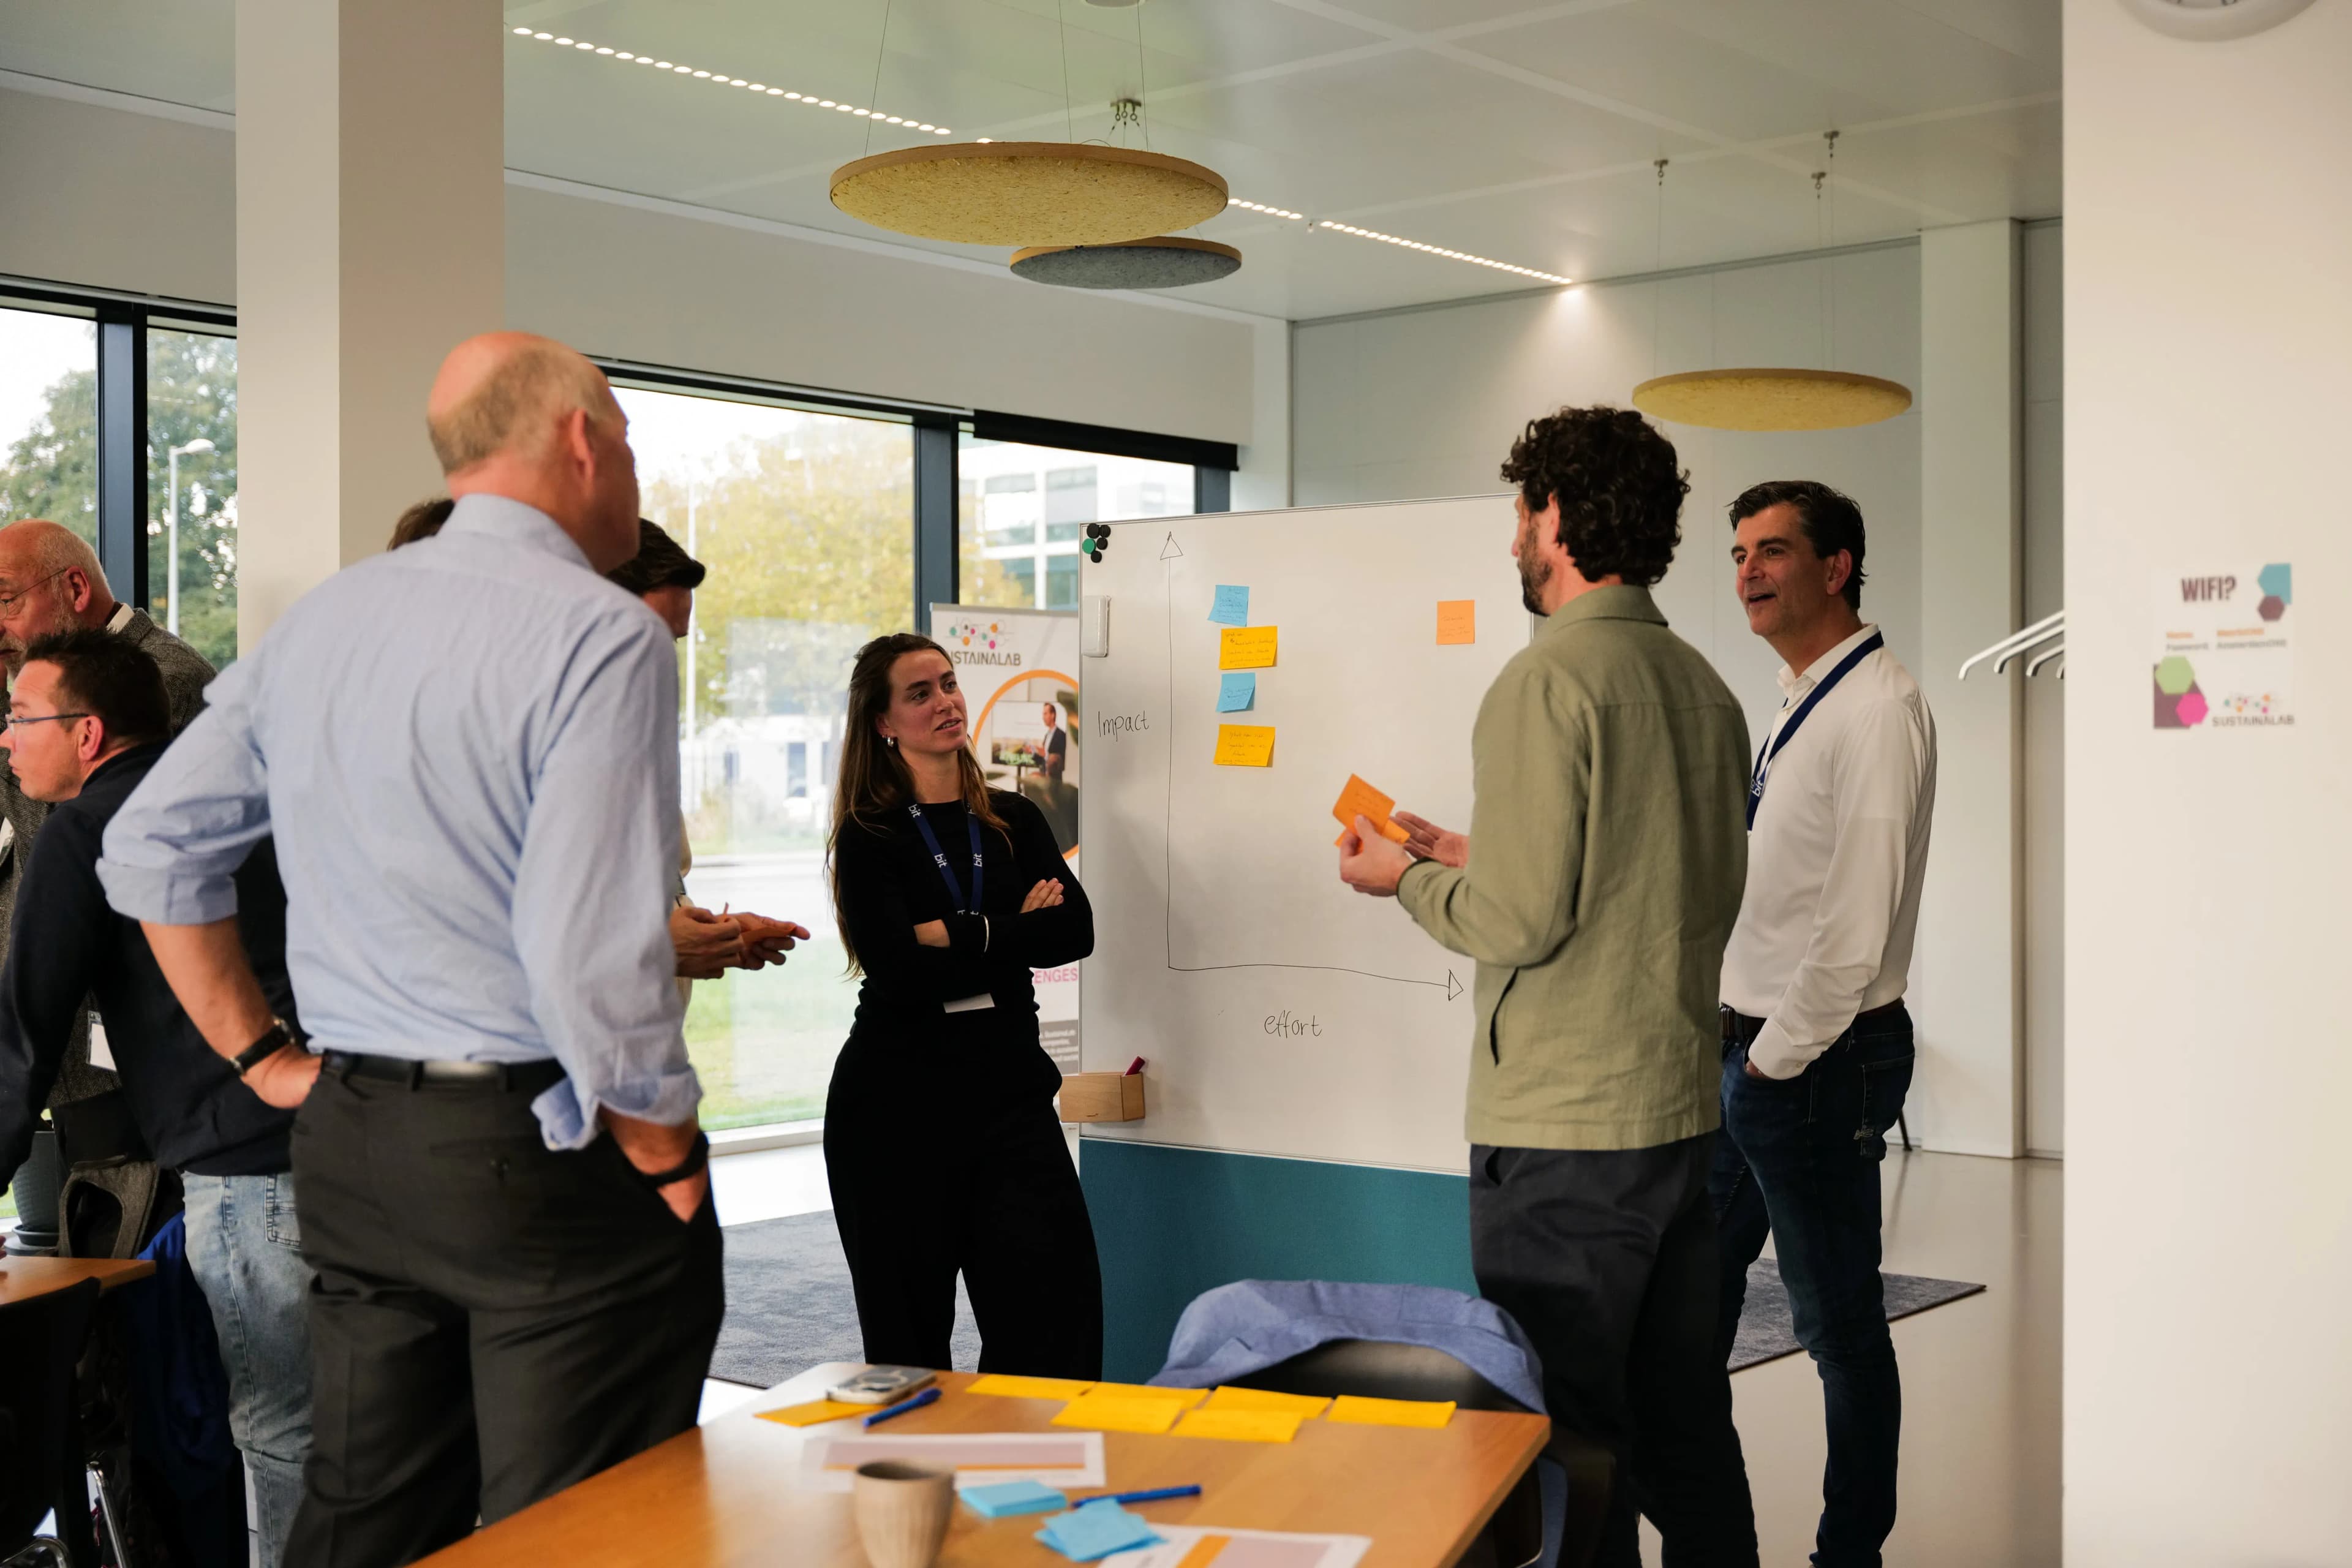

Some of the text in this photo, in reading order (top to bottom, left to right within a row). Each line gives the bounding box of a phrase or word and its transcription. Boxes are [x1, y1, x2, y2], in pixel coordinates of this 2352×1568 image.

[2181, 576, 2236, 602] WIFI?
[950, 650, 1021, 666] STAINALAB
[1098, 710, 1150, 742] Impact
[2212, 714, 2295, 727] SUSTAINALAB
[908, 804, 921, 818] bit
[934, 853, 948, 867] bit
[974, 853, 982, 867] bit
[1034, 968, 1078, 984] ENGES
[1264, 1009, 1322, 1039] effort
